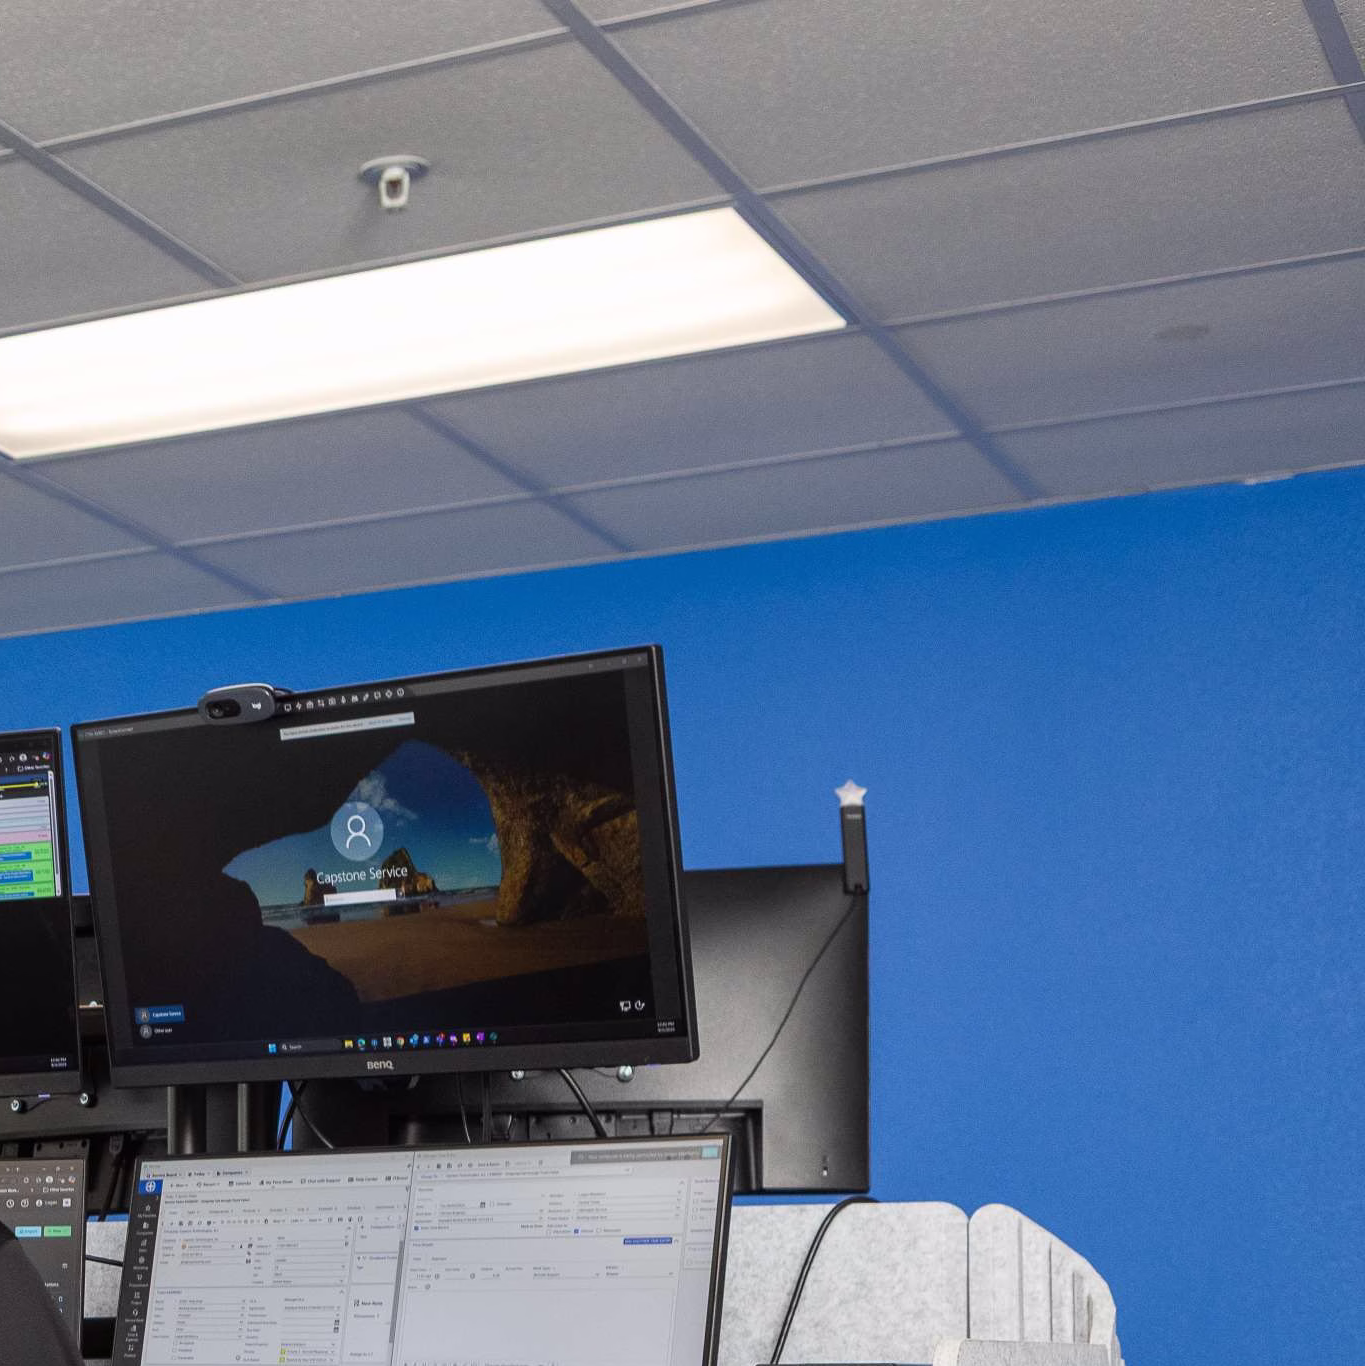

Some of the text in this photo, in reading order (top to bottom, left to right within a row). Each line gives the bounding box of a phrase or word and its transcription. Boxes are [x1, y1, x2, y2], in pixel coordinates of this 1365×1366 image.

[316, 865, 408, 886] Capstone Service
[366, 1060, 394, 1070] BenQ
